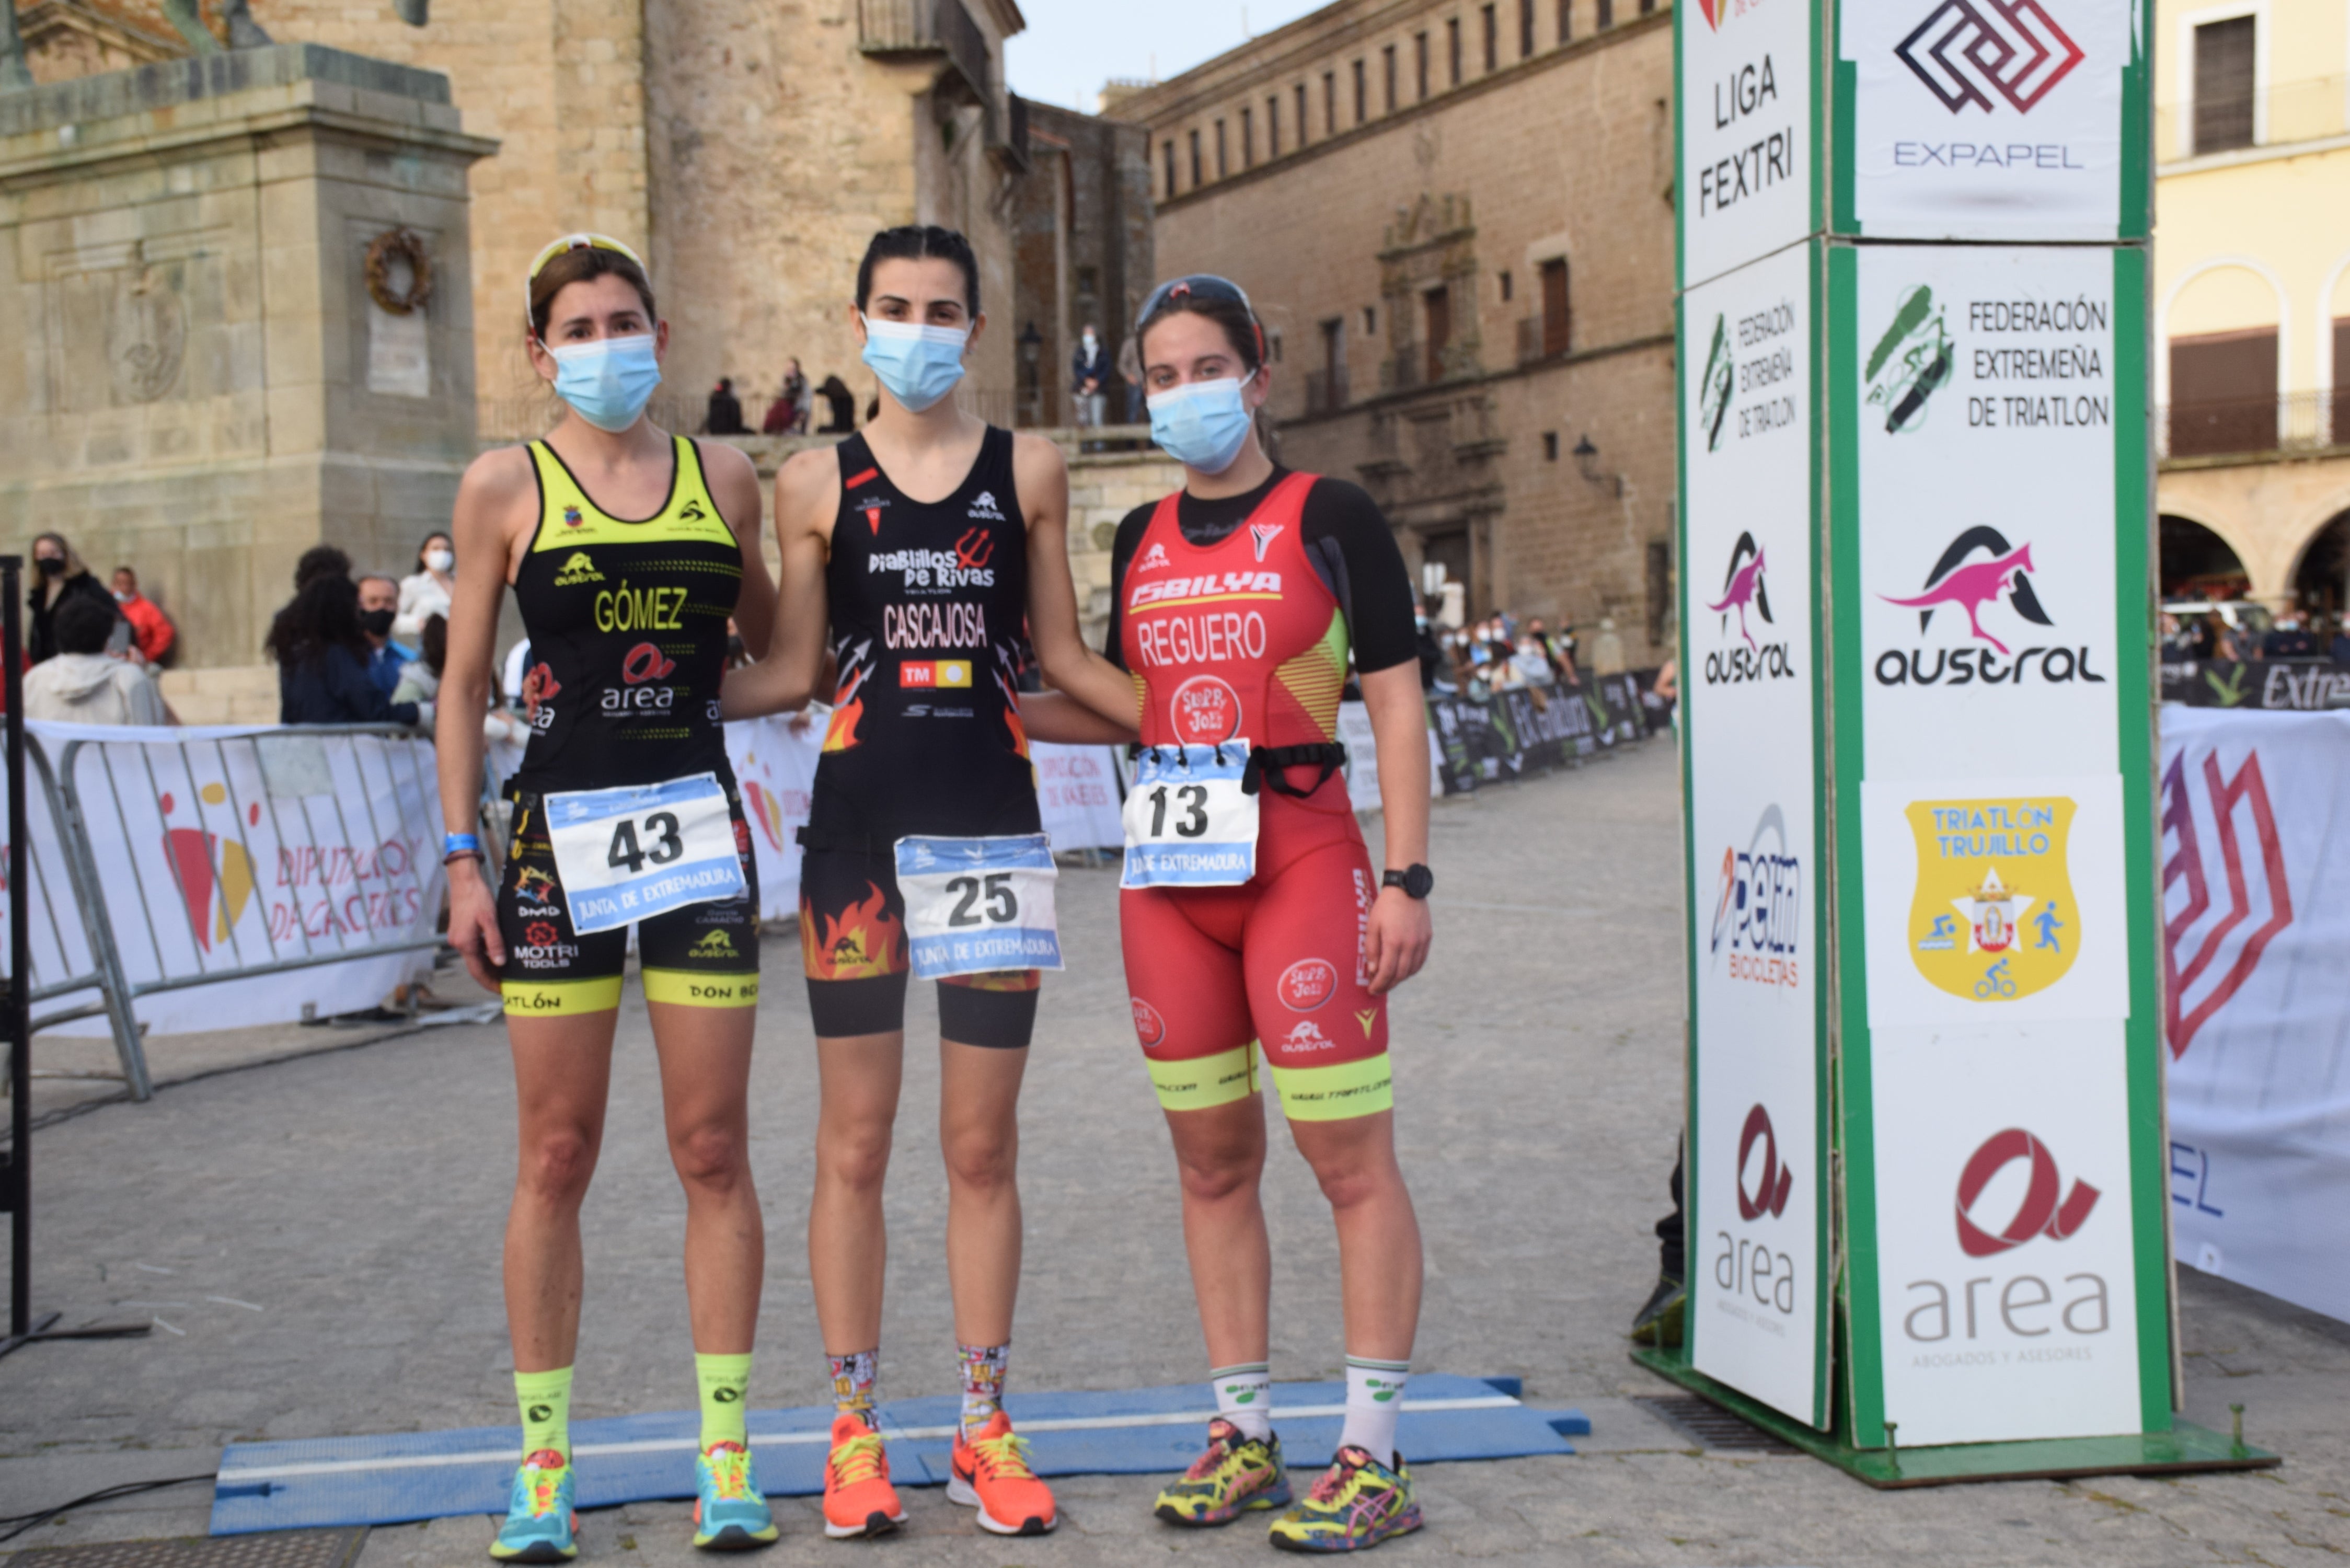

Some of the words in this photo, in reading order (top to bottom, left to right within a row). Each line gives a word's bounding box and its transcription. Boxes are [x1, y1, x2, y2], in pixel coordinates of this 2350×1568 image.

[1715, 53, 1777, 130] LIGA
[1700, 125, 1791, 217] FEXTRI
[1894, 142, 2084, 169] EXPAPEL
[1969, 293, 2106, 332] FEDERACIÓN
[1974, 344, 2103, 379] EXTREMEÑA
[1968, 397, 1996, 426] DE
[2004, 396, 2109, 426] TRIATLON
[594, 579, 688, 633] GÓMEZ
[1131, 571, 1281, 607] ISBILYA
[883, 602, 987, 650] CASCAJOSA
[1137, 610, 1266, 667] REGUERO
[904, 667, 930, 683] TM
[1706, 642, 1795, 686] austral
[1875, 646, 2107, 686] austral
[601, 686, 674, 710] area
[1149, 785, 1208, 837] 13
[1931, 802, 2053, 831] TRIATLÓN
[607, 811, 684, 873] 43
[1937, 833, 2049, 858] TRUJILLO
[1160, 853, 1247, 871] EXTREMADURA
[577, 898, 618, 922] JUNTA
[620, 890, 639, 908] DE
[642, 867, 736, 903] EXTREMADURA
[945, 872, 1018, 927] 25
[513, 944, 579, 960] MOTRI
[917, 944, 949, 966] JUNTA
[953, 943, 968, 961] DE
[974, 937, 1056, 959] EXTREMADURA
[1730, 953, 1799, 988] BICICLETAS
[690, 985, 731, 998] DON
[2170, 1140, 2224, 1218] EL
[1715, 1230, 1793, 1315] area
[1903, 1272, 2110, 1343] area
[2000, 1350, 2011, 1365] Y
